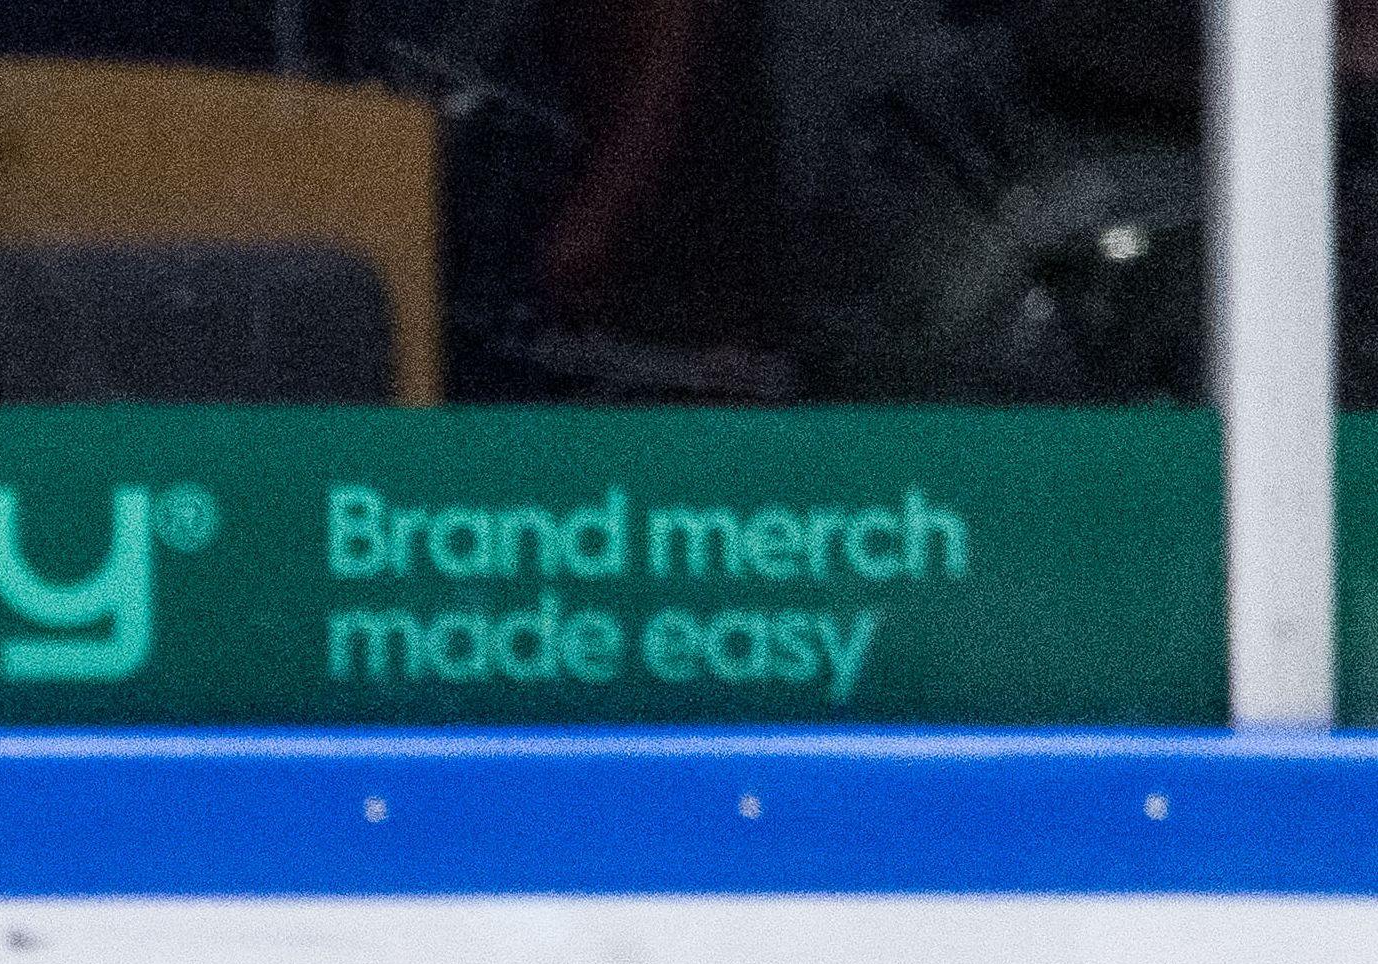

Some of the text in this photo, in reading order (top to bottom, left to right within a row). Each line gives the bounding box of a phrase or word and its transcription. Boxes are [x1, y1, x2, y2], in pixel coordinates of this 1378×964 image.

[328, 484, 970, 580] Brand merch
[328, 590, 881, 704] made easy
